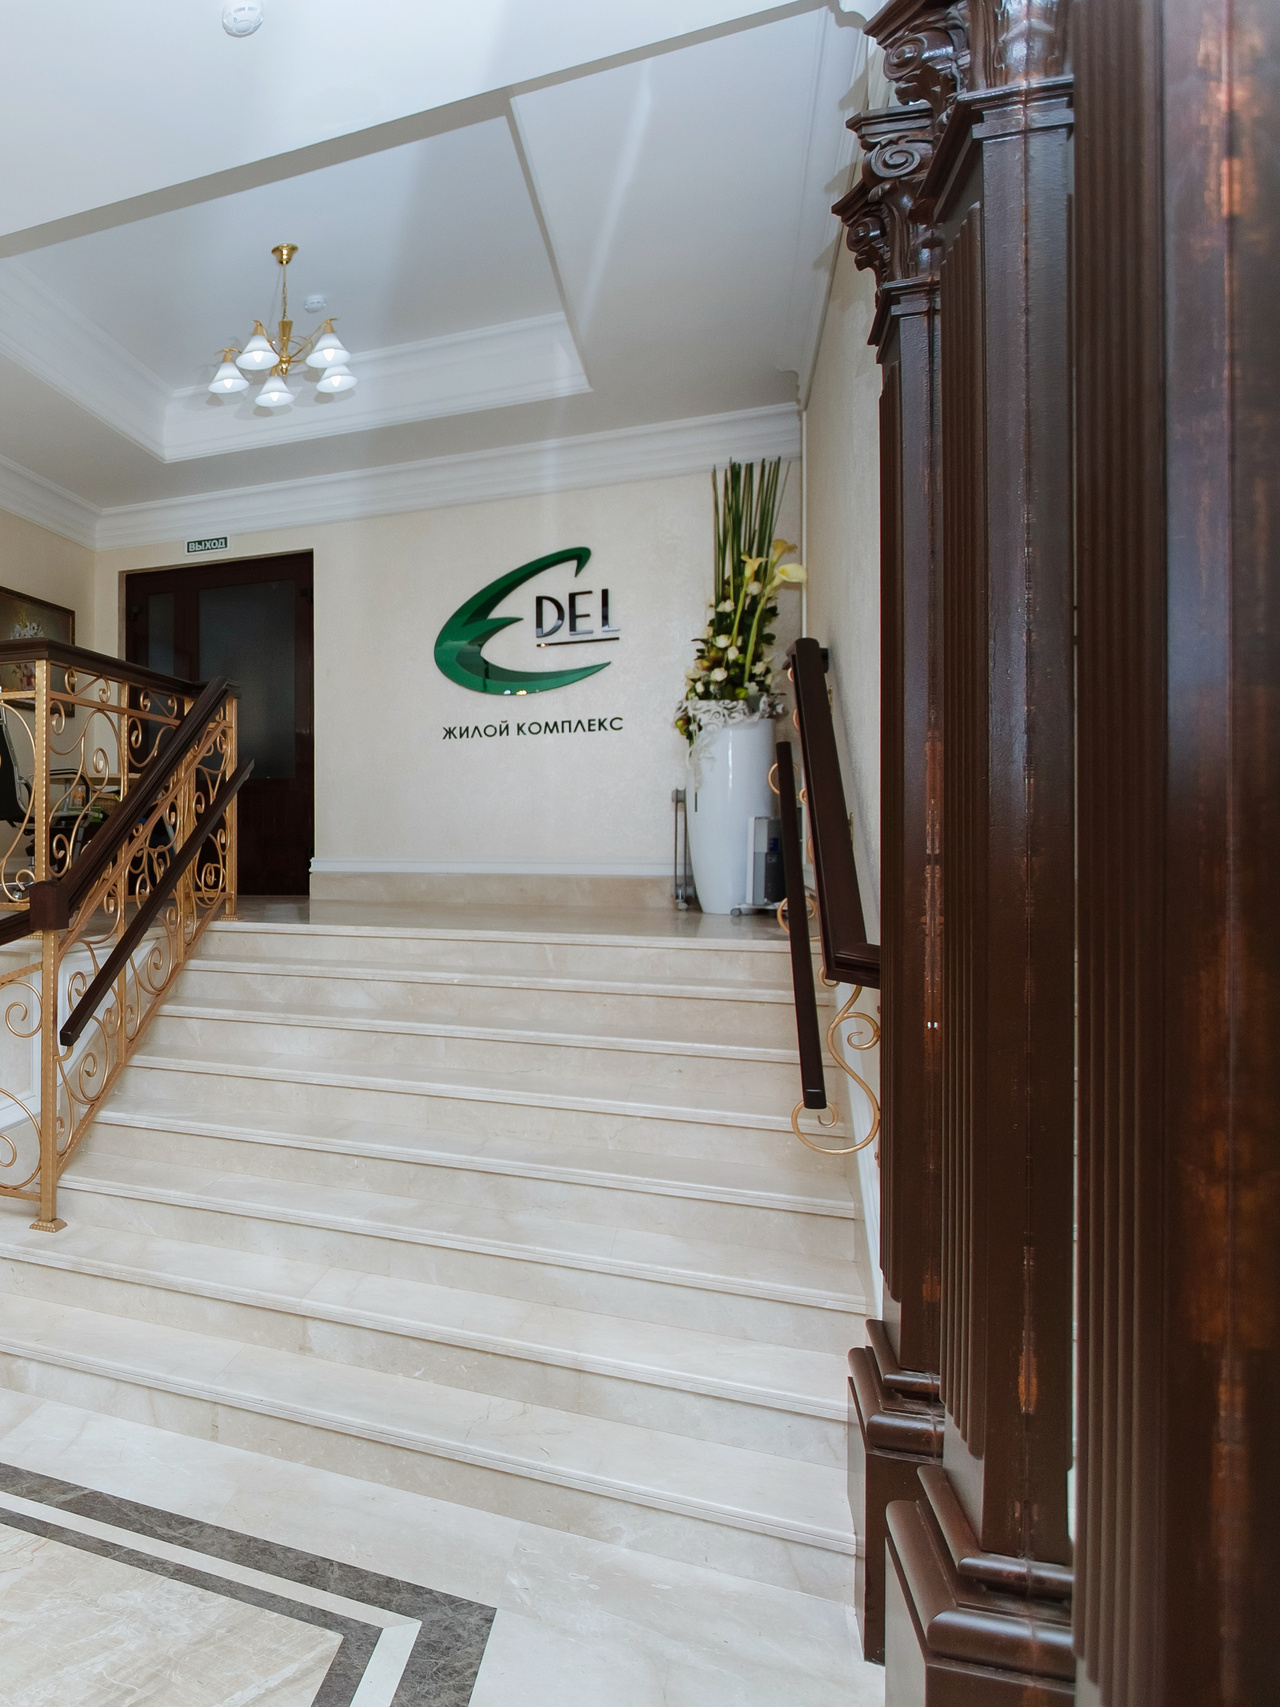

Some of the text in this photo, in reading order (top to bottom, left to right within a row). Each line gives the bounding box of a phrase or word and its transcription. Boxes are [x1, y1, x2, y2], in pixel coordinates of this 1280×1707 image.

[188, 538, 226, 552] ВЫХОД
[442, 716, 624, 740] ЖИЛОЙ КОМПЛЕКС
